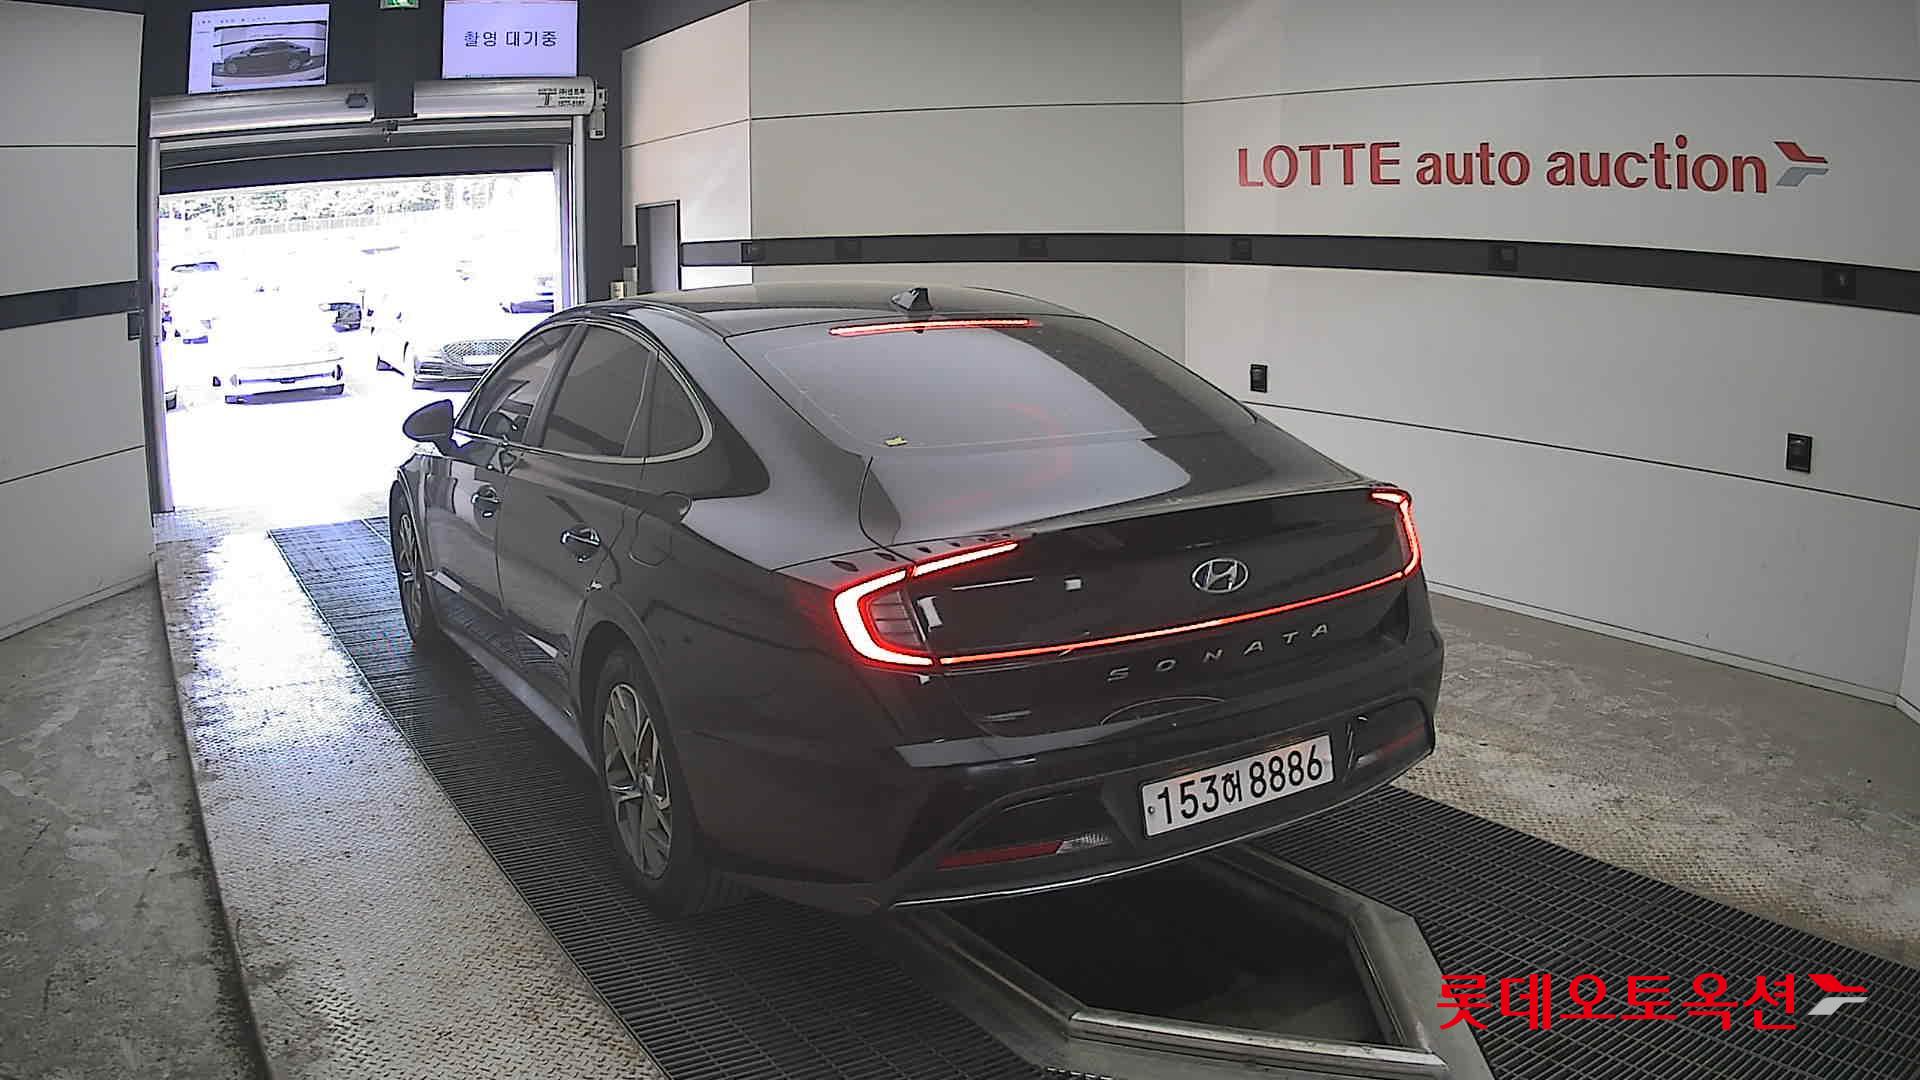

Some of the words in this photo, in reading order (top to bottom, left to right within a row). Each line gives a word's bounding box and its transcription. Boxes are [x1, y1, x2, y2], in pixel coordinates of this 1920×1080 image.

[505, 30, 558, 47] 대기중
[1237, 142, 1400, 188] LOTTE
[1416, 142, 1532, 186] auto
[1546, 135, 1768, 193] auction
[1107, 624, 1329, 682] SONATA
